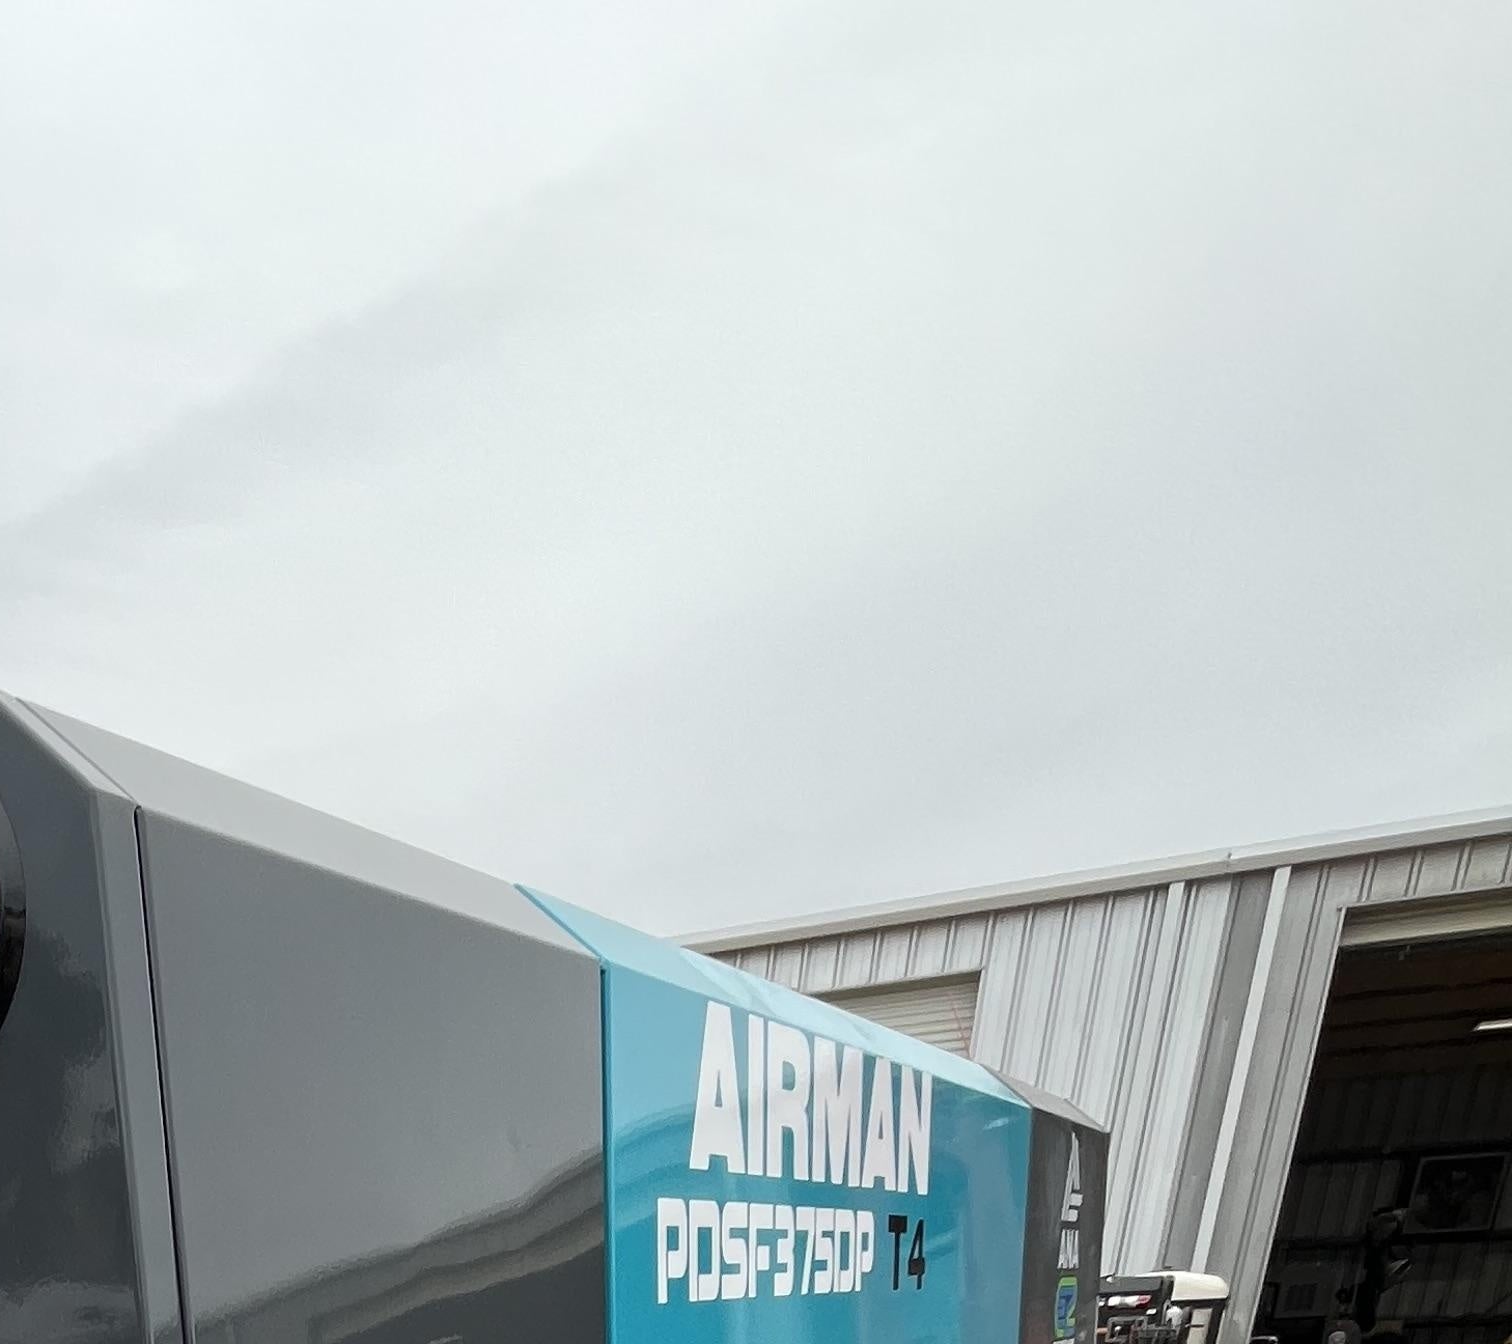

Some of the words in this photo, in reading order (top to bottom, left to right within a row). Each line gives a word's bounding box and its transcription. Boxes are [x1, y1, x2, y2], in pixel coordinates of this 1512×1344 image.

[689, 1000, 933, 1195] AIRMAN
[657, 1197, 875, 1305] PDSF375DP
[888, 1214, 926, 1291] T4
